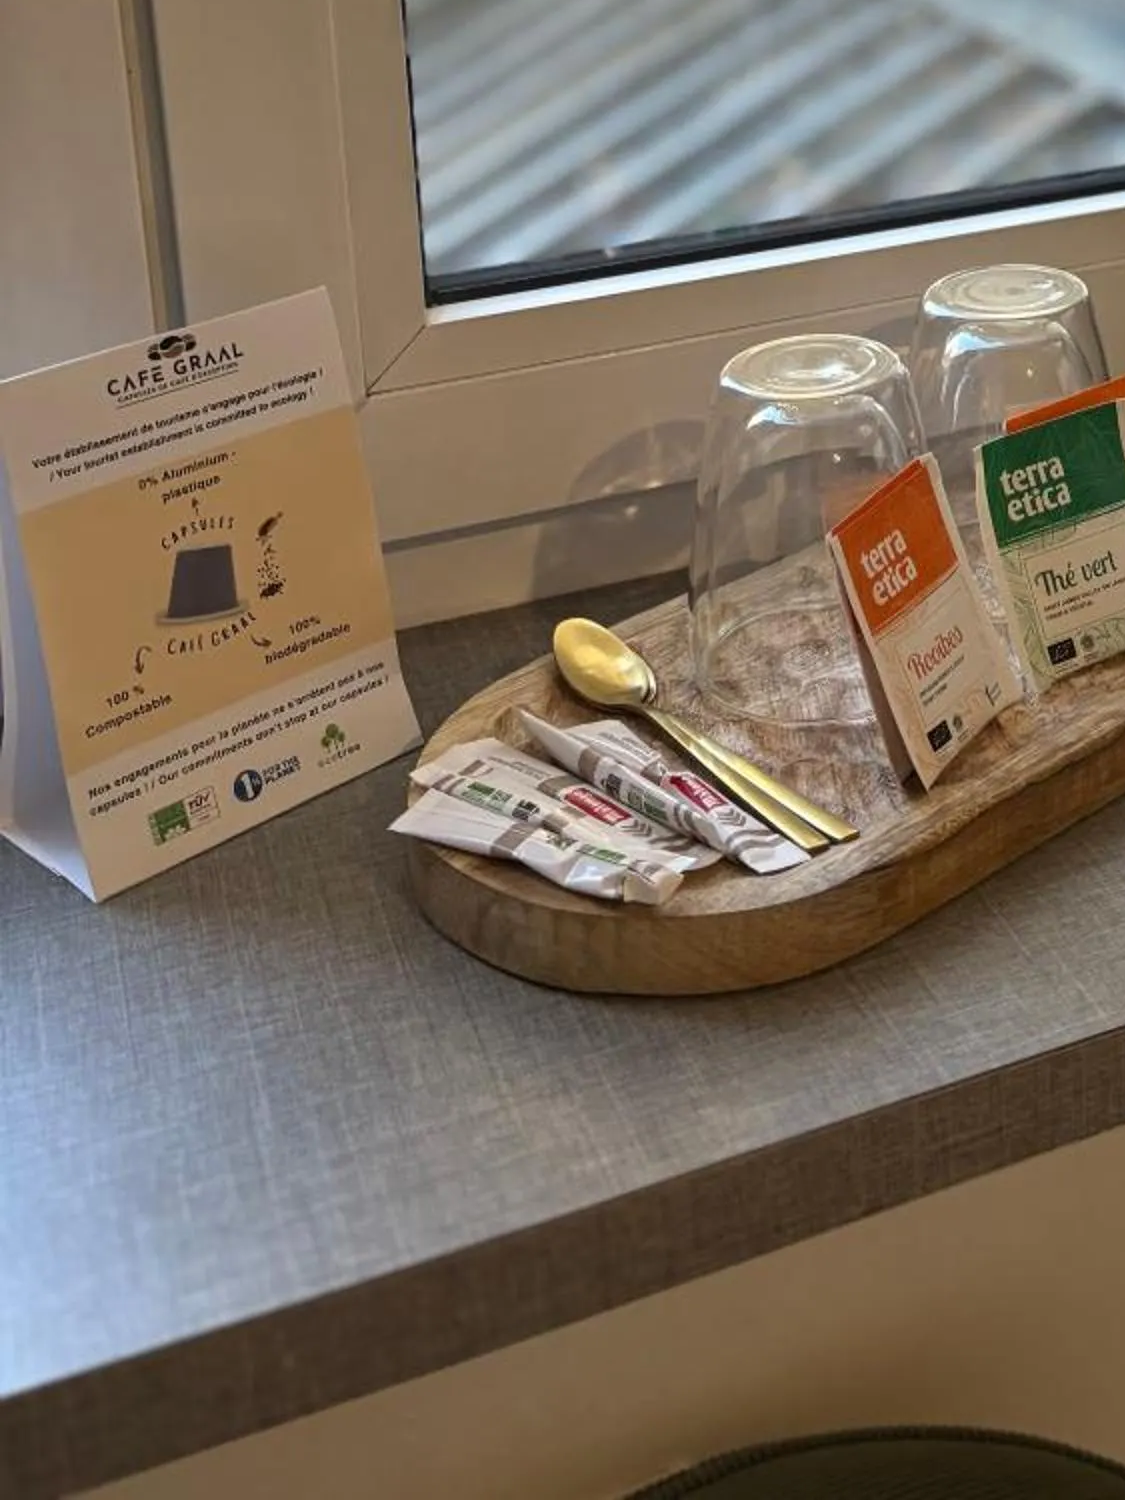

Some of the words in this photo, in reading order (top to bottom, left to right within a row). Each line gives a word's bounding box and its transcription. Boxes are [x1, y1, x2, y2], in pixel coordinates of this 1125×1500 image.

[173, 342, 244, 375] GRAAL
[32, 453, 61, 469] Votre
[140, 422, 154, 434] de
[155, 408, 201, 430] tourisme
[248, 385, 270, 402] pour
[56, 465, 82, 479] Your
[84, 451, 120, 470] tourist
[121, 426, 193, 458] establishment
[194, 423, 205, 433] is
[205, 405, 257, 429] committed
[258, 402, 269, 413] to
[270, 390, 307, 409] ecology
[138, 476, 159, 491] 0%
[161, 451, 230, 482] Aluminium
[161, 475, 221, 505] plastique
[998, 455, 1066, 497] terra
[1006, 479, 1072, 522] etica
[859, 527, 908, 580] terra
[1034, 560, 1078, 597] Thé
[1080, 549, 1118, 582] vert
[871, 554, 918, 607] etica
[264, 623, 351, 665] biodégradable
[288, 615, 321, 635] 100%
[84, 694, 174, 740] Compostable
[105, 690, 130, 709] 100
[87, 783, 111, 800] Nos
[113, 748, 190, 787] engagements
[191, 735, 217, 755] pour
[219, 729, 229, 740] la
[271, 704, 286, 717] ne
[337, 674, 356, 688] pas
[365, 661, 385, 675] nos
[89, 787, 142, 817] capsules
[158, 771, 179, 786] Our
[181, 734, 254, 775] commitments
[255, 722, 283, 742] don't
[284, 711, 307, 729] stop
[309, 706, 320, 718] at
[321, 699, 338, 712] our
[339, 679, 384, 704] capsules
